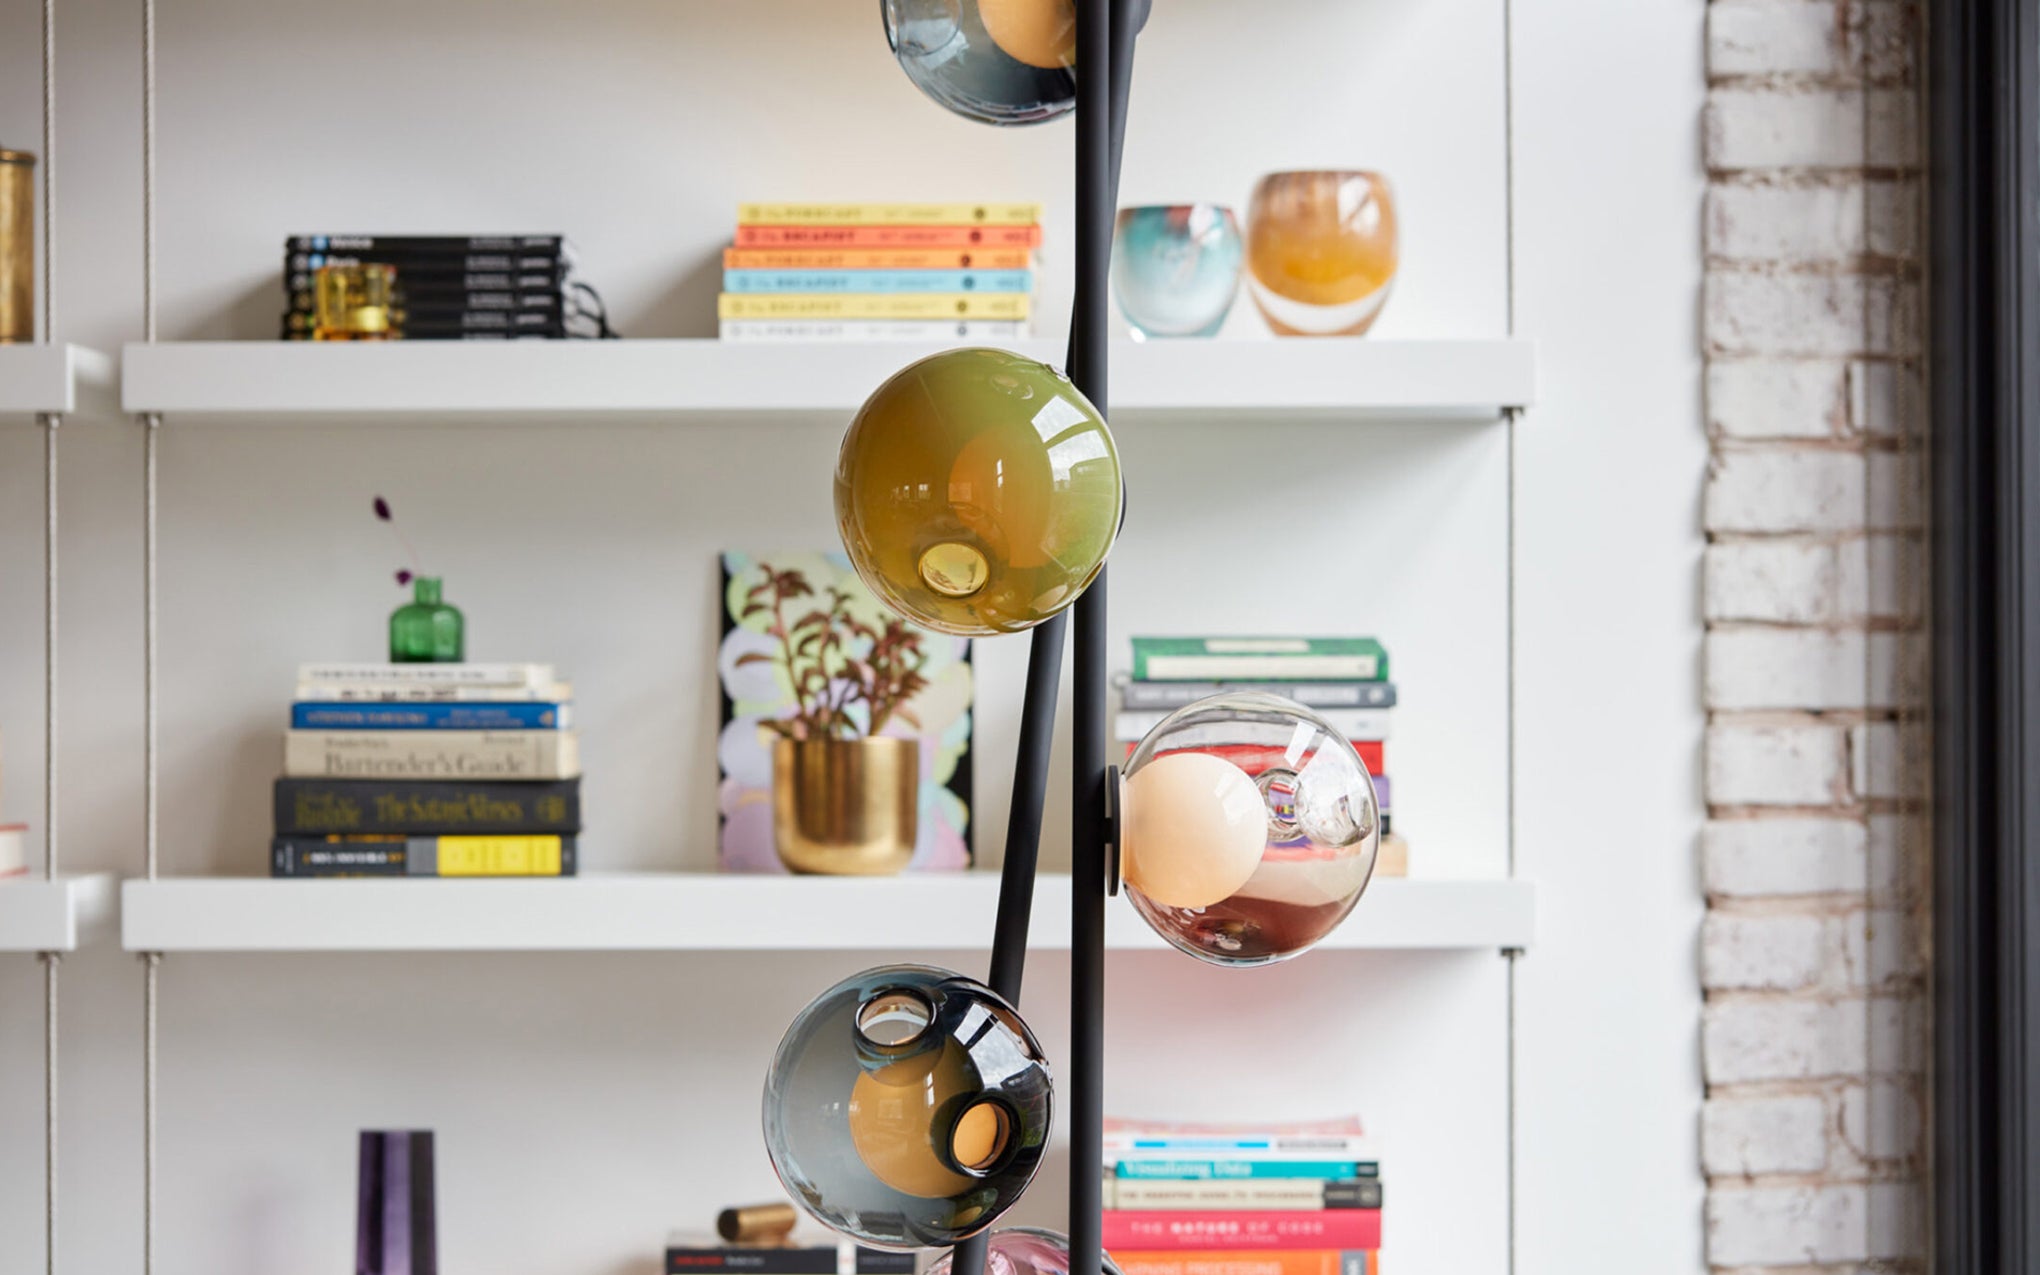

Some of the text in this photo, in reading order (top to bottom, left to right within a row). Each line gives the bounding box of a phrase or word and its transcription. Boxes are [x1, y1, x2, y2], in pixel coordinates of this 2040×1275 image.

[325, 750, 525, 774] Bartender's Guide
[1131, 1221, 1324, 1235] THE NATURE OF CODE
